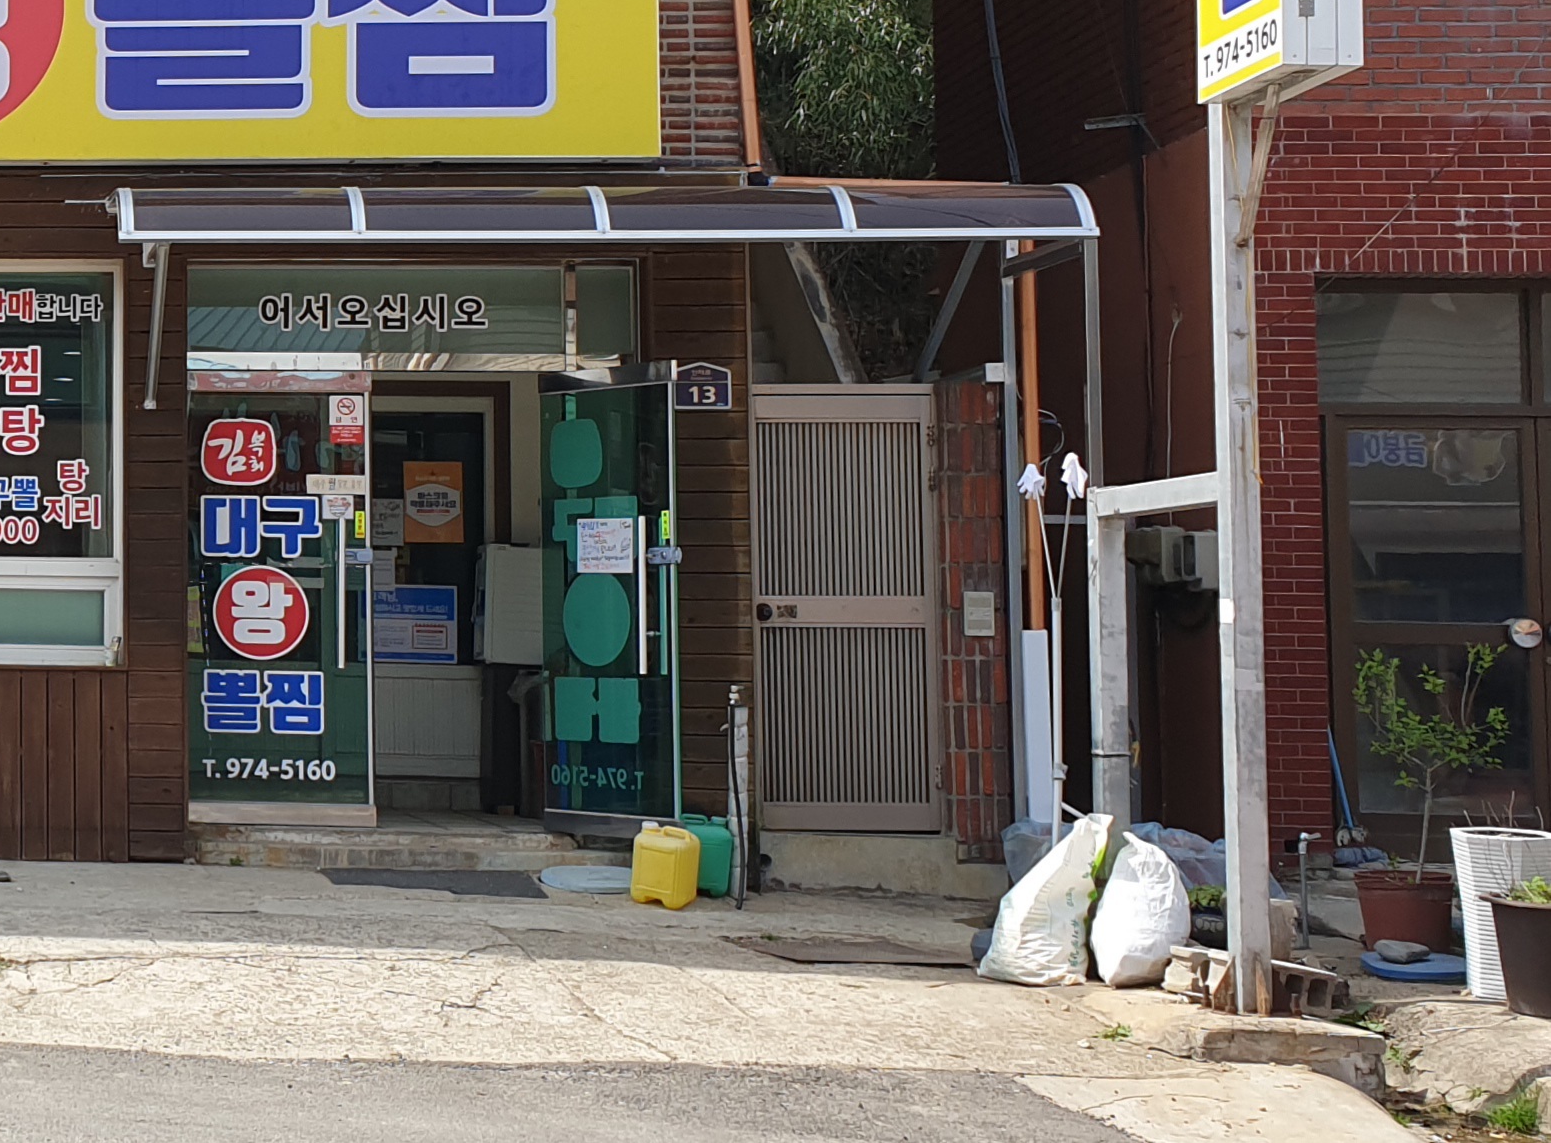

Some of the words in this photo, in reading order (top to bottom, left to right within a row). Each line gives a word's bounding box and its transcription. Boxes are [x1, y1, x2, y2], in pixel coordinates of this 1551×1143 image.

[1216, 18, 1278, 73] 974-5160
[258, 292, 489, 332] 어서오십시오
[688, 385, 716, 404] 13
[57, 458, 90, 495] 탕
[41, 494, 102, 530] 지리
[200, 494, 322, 558] 대구
[229, 579, 295, 645] 왕
[201, 668, 325, 735] 뽈찜
[202, 759, 221, 779] T.
[227, 759, 337, 781] 974-5160
